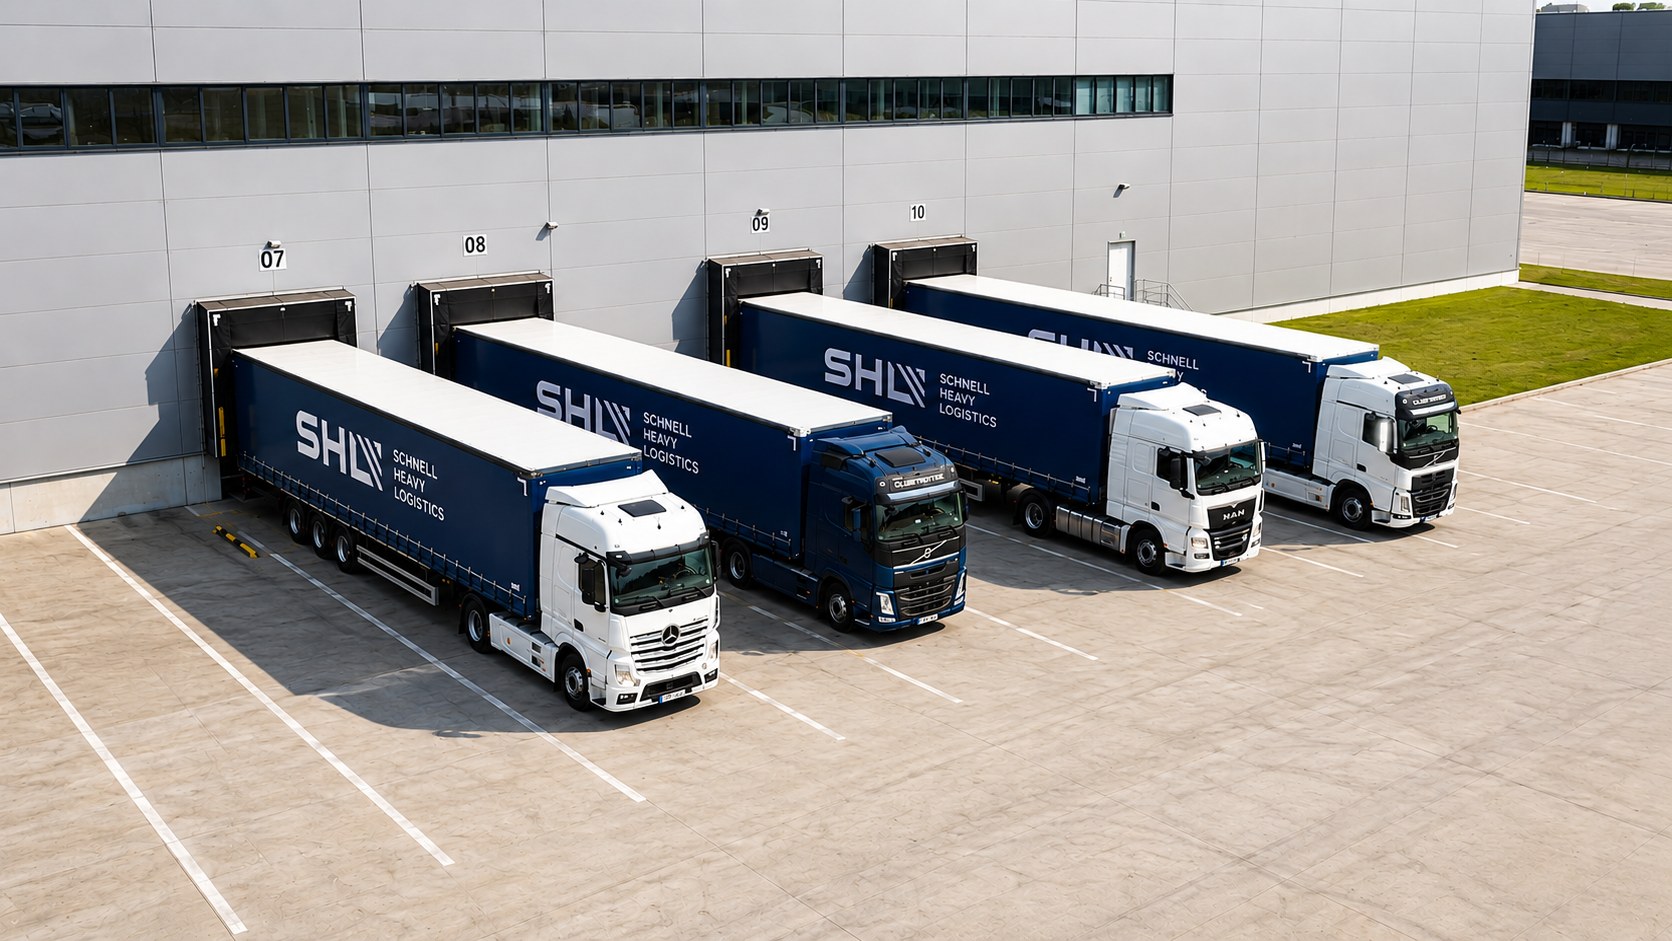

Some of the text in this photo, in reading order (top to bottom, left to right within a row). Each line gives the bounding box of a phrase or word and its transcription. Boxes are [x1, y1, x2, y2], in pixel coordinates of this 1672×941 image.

[752, 216, 769, 231] 09
[910, 205, 925, 219] 10
[465, 236, 486, 253] 08
[260, 250, 284, 268] 07
[1147, 350, 1199, 370] SCHNELL
[824, 347, 926, 408] SHL
[939, 373, 990, 396] SCHNELL
[939, 387, 976, 407] HEAVY
[536, 380, 631, 445] SHL
[643, 411, 692, 438] SCHNELL
[939, 402, 997, 428] LOGISTICS
[296, 410, 383, 491] SHL
[643, 427, 678, 449] HEAVY
[393, 449, 438, 480] SCHNELL
[643, 444, 699, 474] LOGISTICS
[393, 467, 426, 493] HEAVY
[394, 486, 445, 521] LOGISTICS
